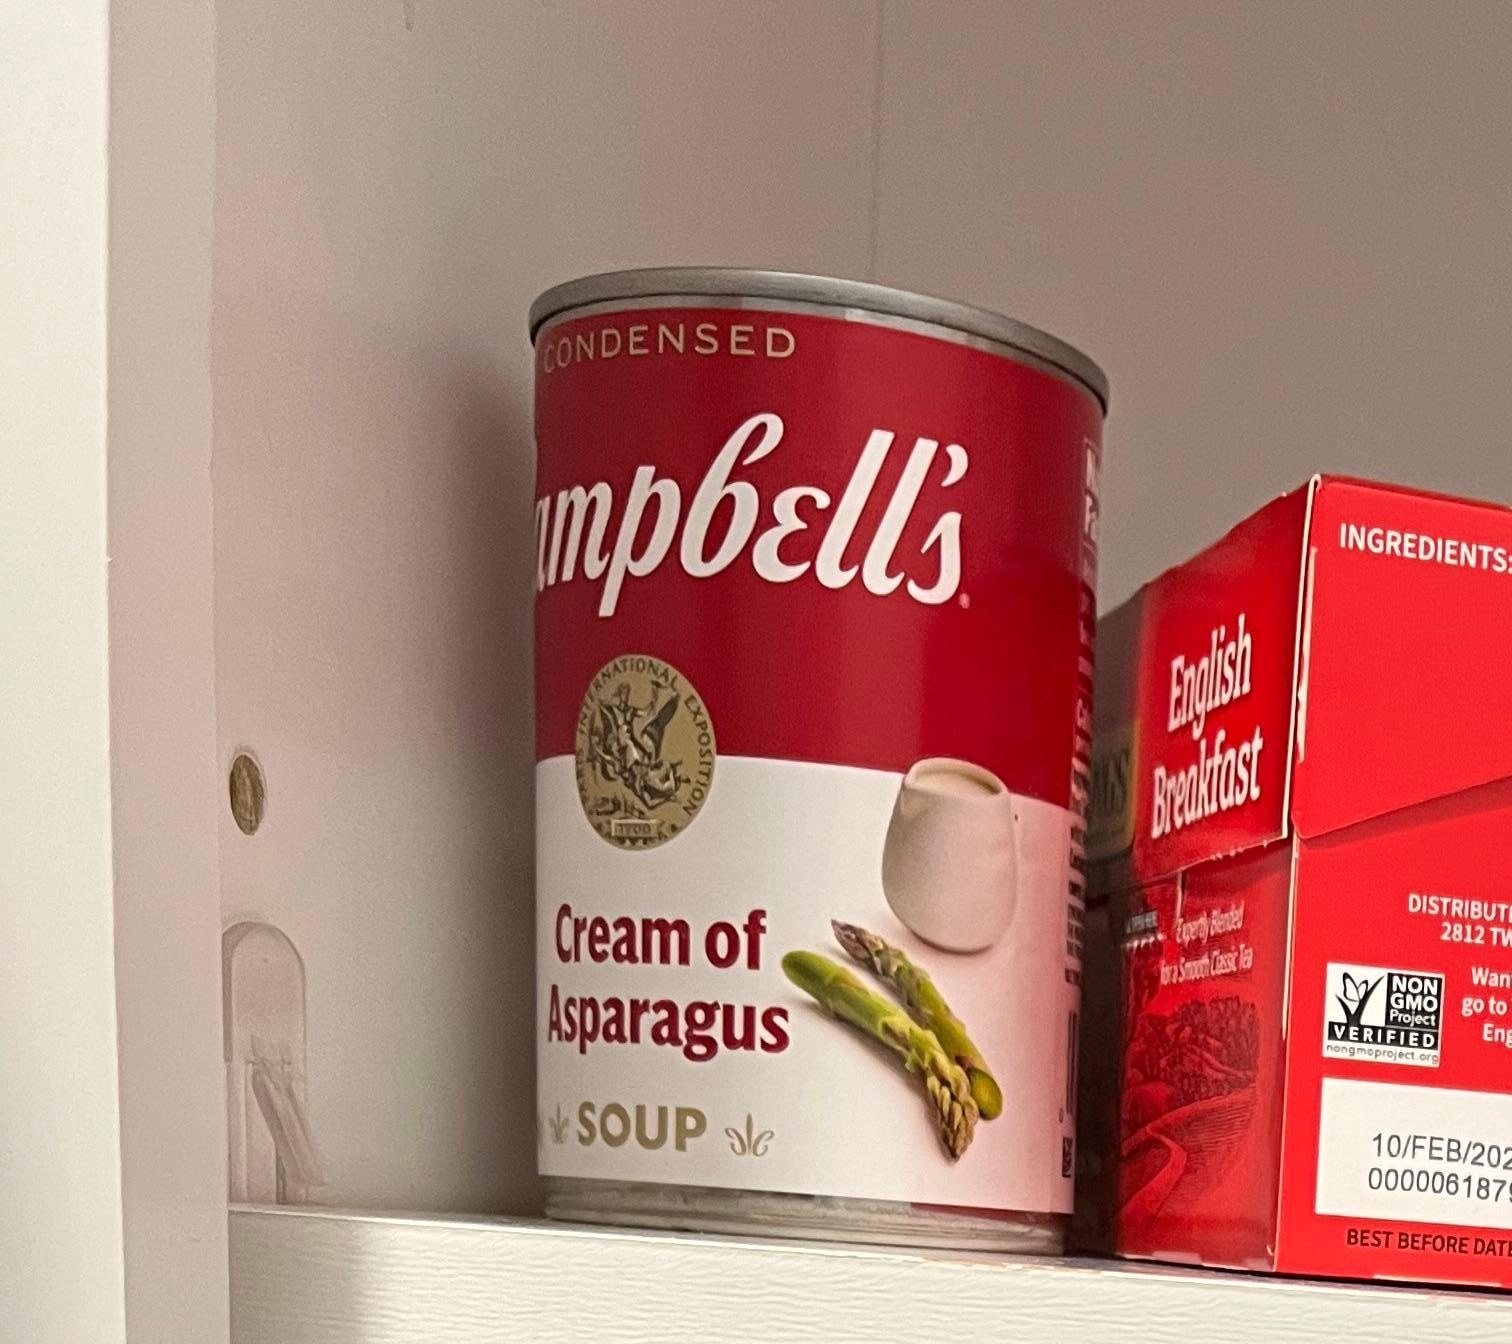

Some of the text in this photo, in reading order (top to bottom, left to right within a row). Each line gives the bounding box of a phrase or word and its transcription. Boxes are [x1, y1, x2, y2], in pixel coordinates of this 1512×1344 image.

[542, 323, 796, 373] CONDENSED
[536, 412, 969, 618] ampbell's
[1167, 613, 1251, 740] English
[684, 694, 716, 817] EXPOSITION
[1151, 725, 1263, 839] Breakfast
[555, 903, 766, 970] Cream of
[1440, 921, 1485, 945] 2812
[1390, 992, 1438, 1012] GMO
[1392, 975, 1438, 996] NON
[548, 984, 790, 1062] Asparagus
[1390, 1009, 1436, 1027] Project
[1461, 996, 1485, 1017] go
[1488, 995, 1508, 1015] to
[1326, 1044, 1439, 1064] nongmoproject.org
[1333, 1024, 1435, 1048] VERIFIED
[577, 1101, 707, 1153] SOUP
[1346, 1228, 1394, 1249] BEST
[1398, 1231, 1470, 1255] BEFORE
